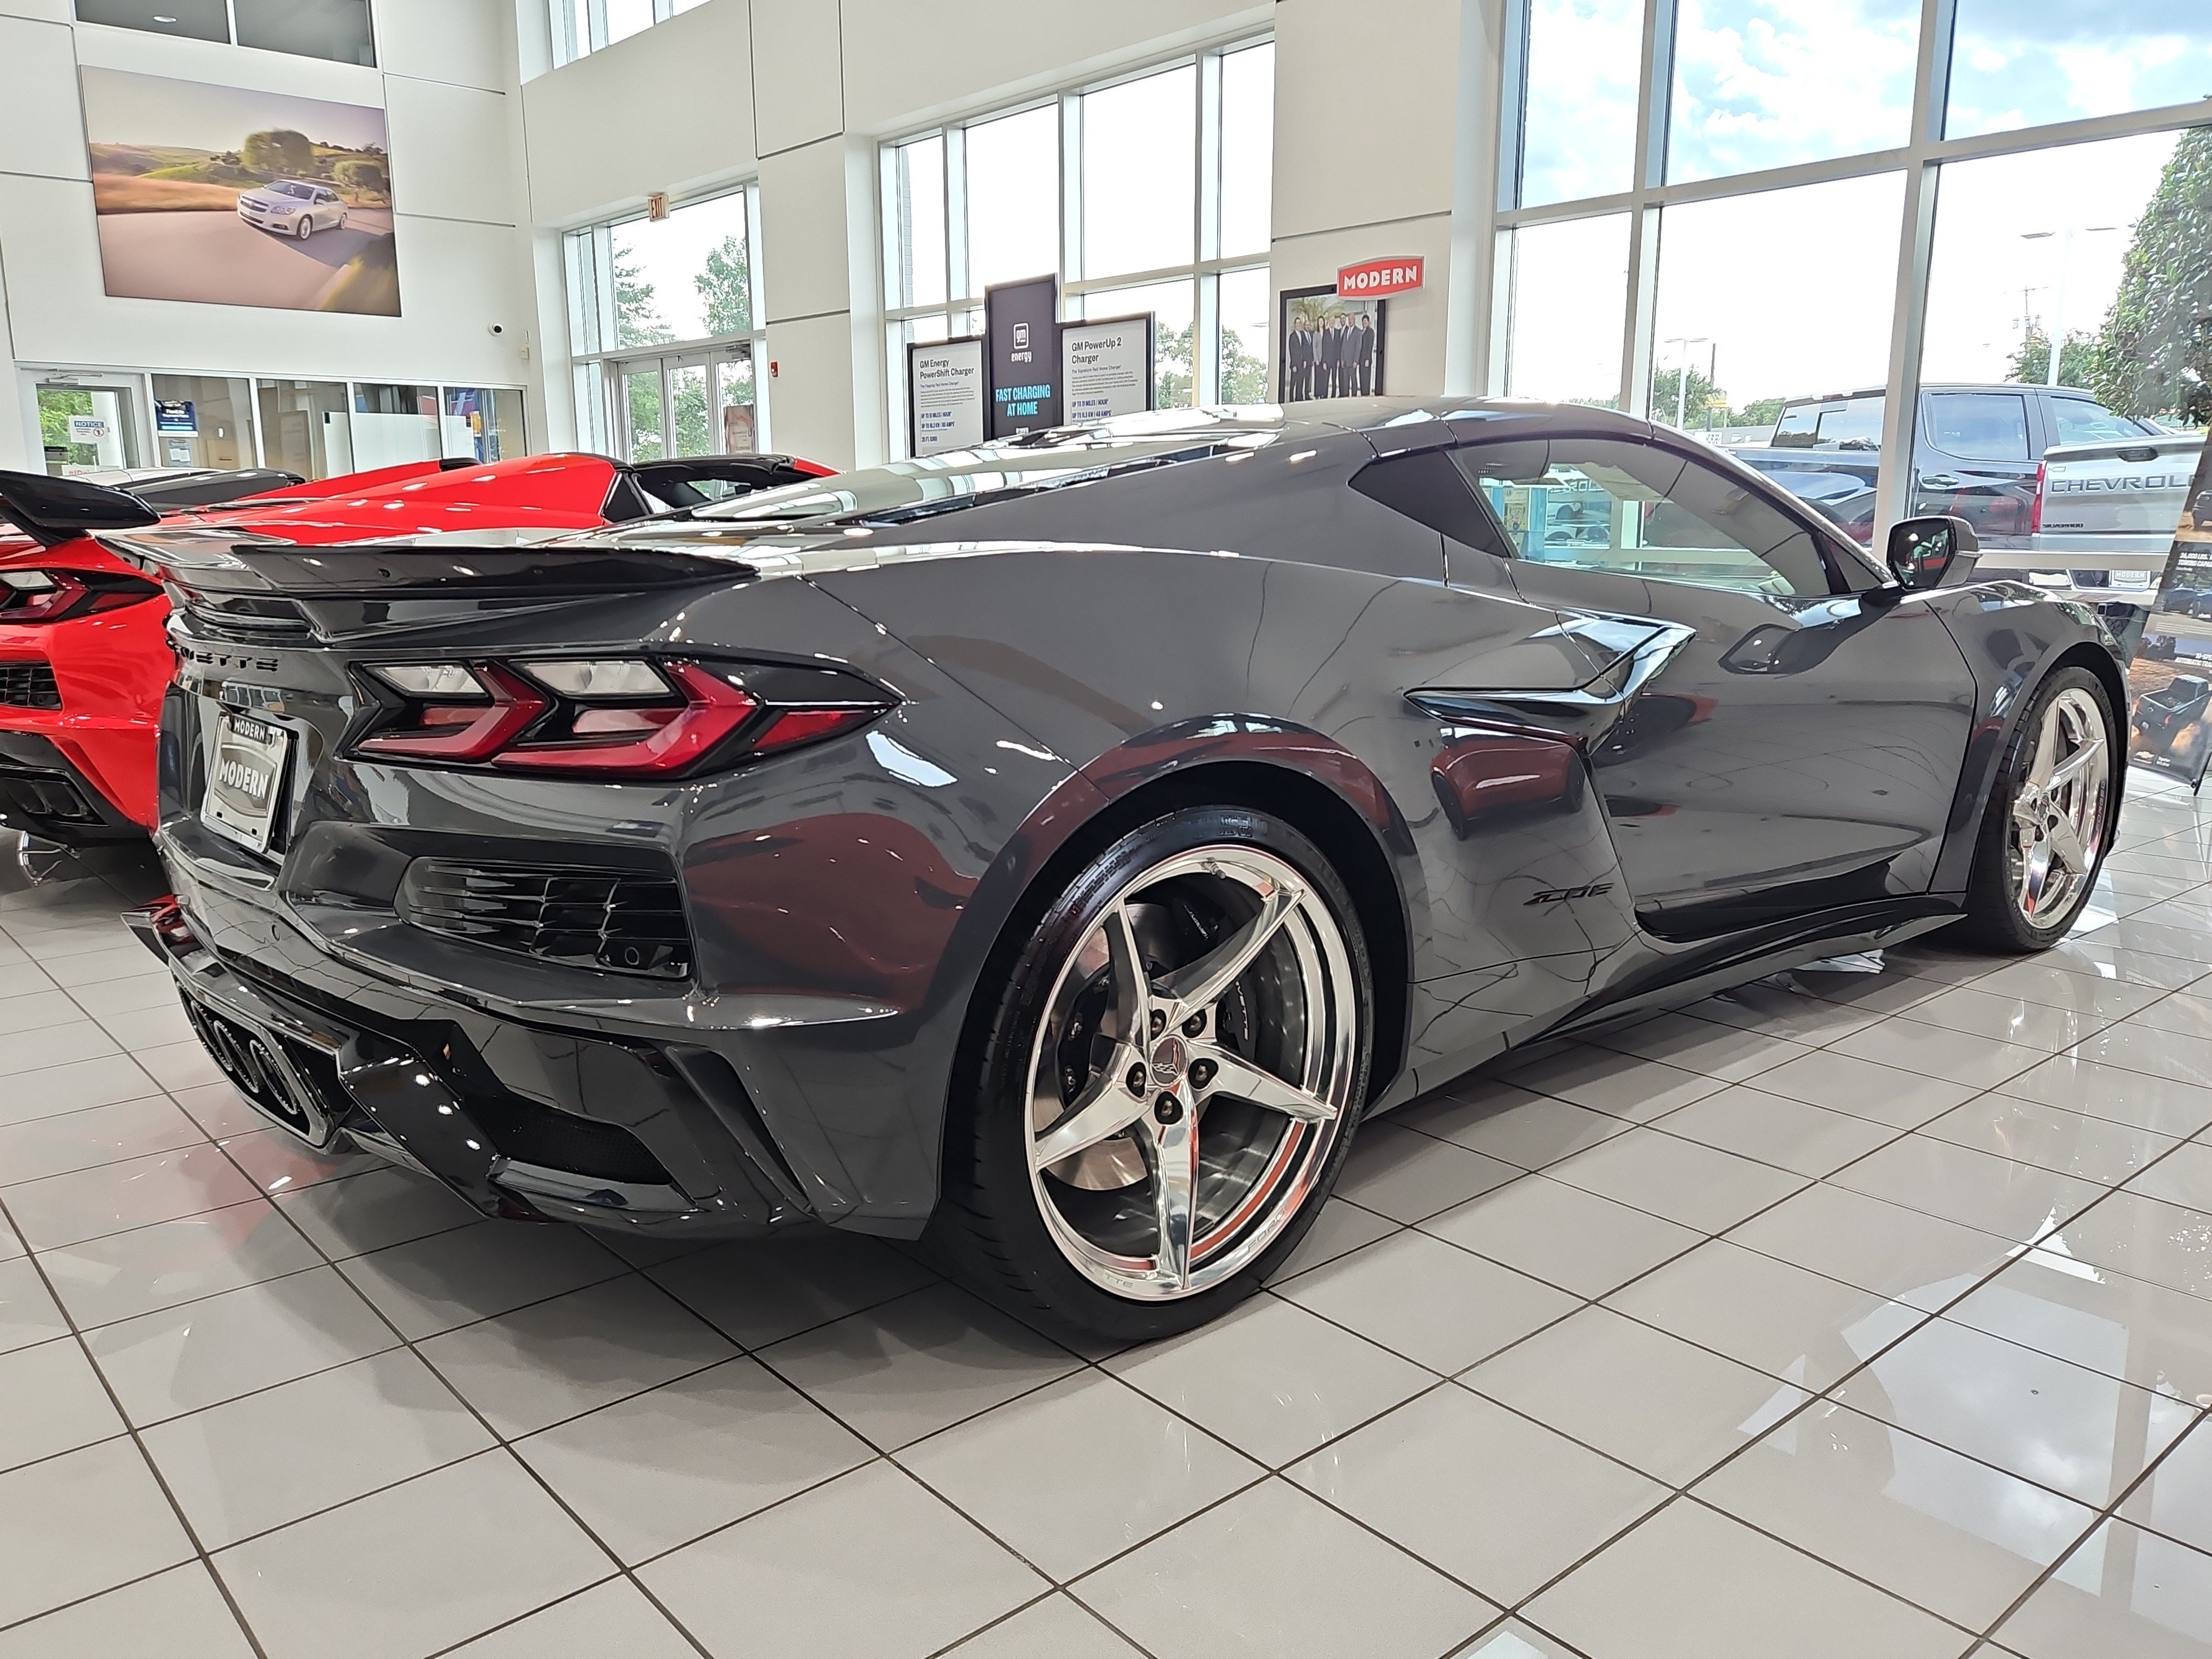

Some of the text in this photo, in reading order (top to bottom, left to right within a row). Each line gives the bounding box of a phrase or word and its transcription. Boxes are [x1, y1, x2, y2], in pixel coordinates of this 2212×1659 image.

[651, 196, 663, 218] EXIT
[1343, 265, 1417, 291] MODERN
[1016, 329, 1026, 343] gm
[1072, 337, 1122, 351] GM PowerUp 2
[919, 359, 949, 369] GM Energy
[1011, 351, 1032, 363] energy
[1071, 354, 1099, 364] Charger
[920, 368, 974, 379] PowerShift Charger
[995, 384, 1051, 402] FAST CHARGING
[1007, 401, 1038, 417] AT HOME
[234, 718, 265, 741] MODERN
[218, 757, 269, 800] MODERN
